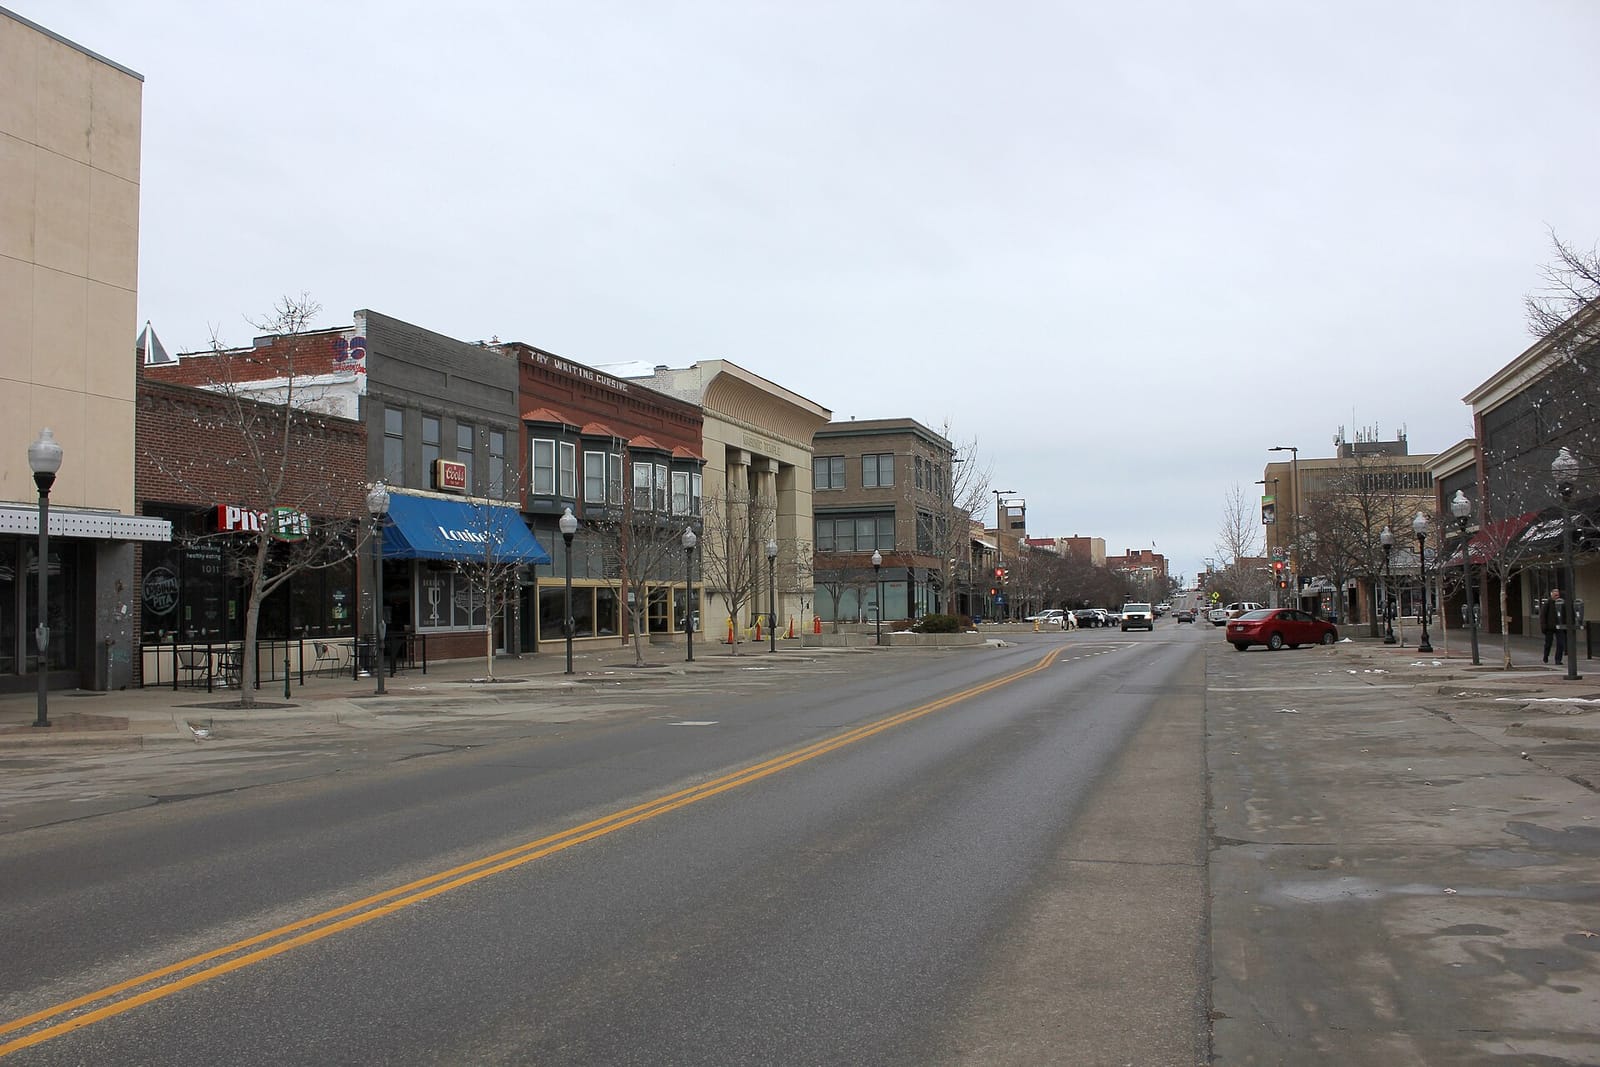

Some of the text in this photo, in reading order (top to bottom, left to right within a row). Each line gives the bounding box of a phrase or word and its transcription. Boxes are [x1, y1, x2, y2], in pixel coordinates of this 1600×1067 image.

[554, 359, 594, 380] WRITING
[596, 374, 629, 392] CURSIVE
[153, 594, 173, 608] PITA
